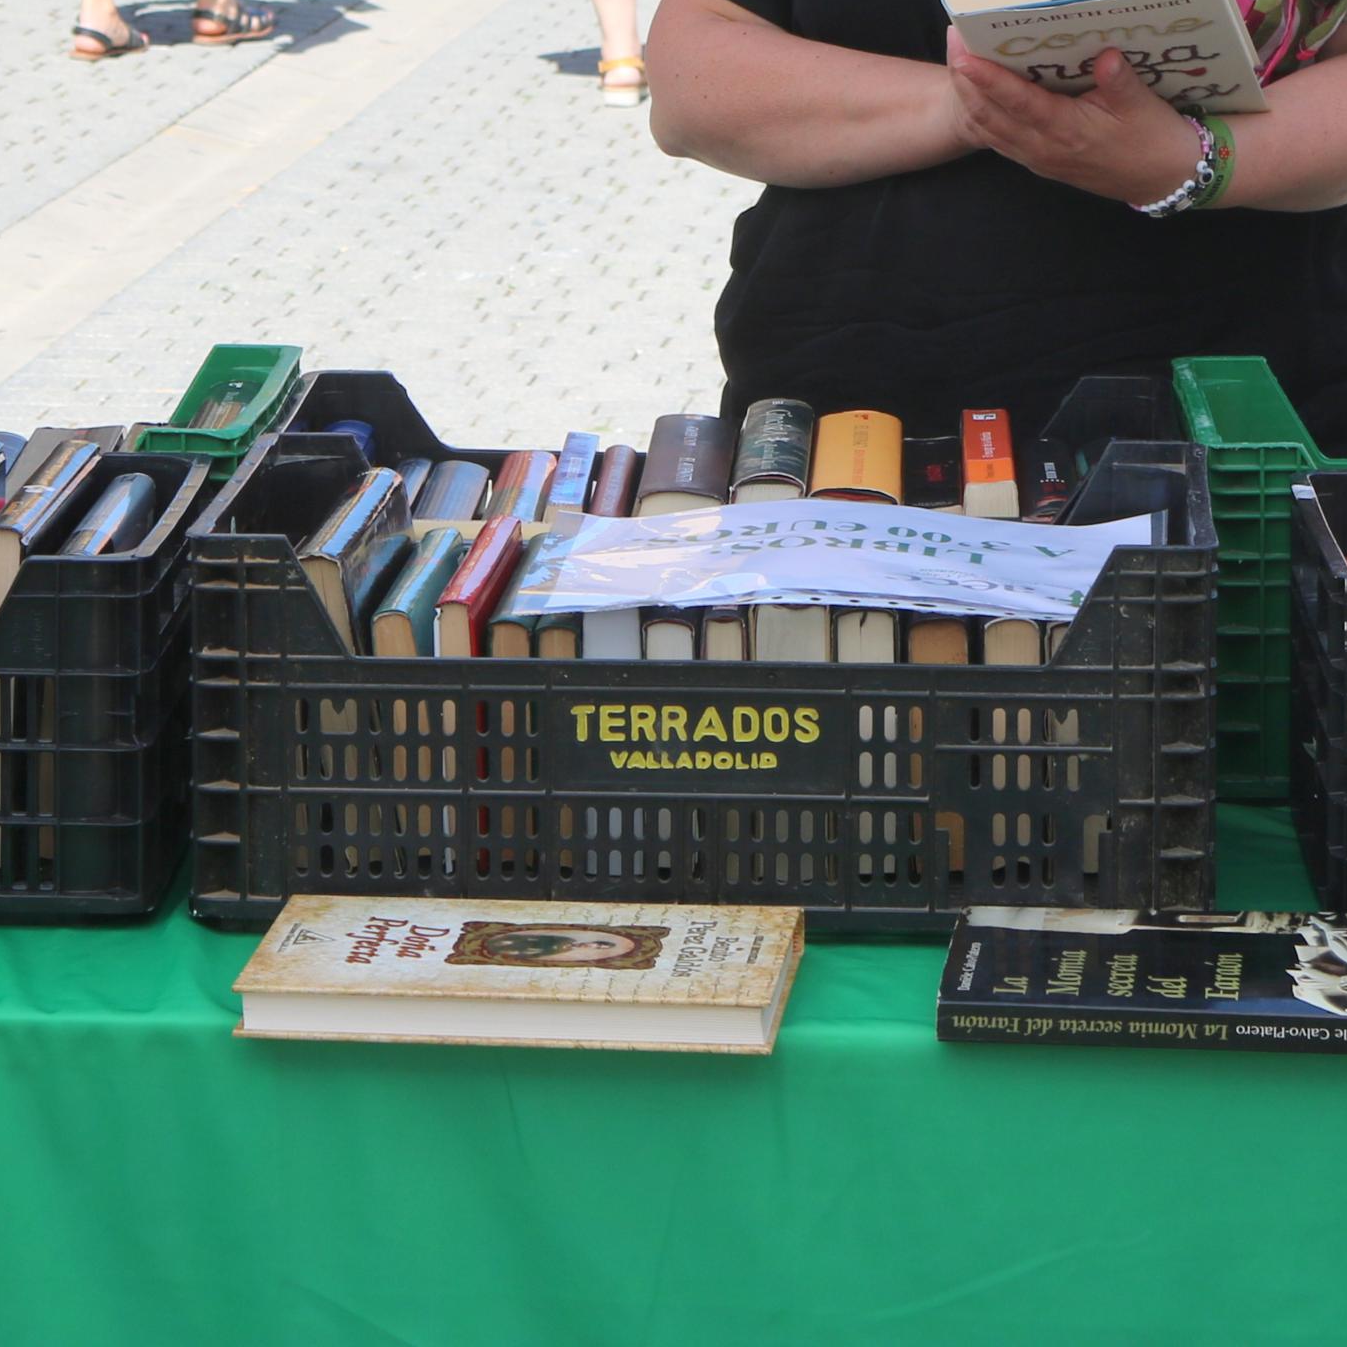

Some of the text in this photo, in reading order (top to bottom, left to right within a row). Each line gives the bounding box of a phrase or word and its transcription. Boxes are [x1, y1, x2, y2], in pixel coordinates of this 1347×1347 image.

[990, 10, 1104, 30] ELIZABETH
[993, 16, 1215, 57] come
[710, 536, 987, 566] LIBROS:
[1032, 545, 1075, 558] A
[570, 705, 820, 744] TERRADOS
[610, 751, 778, 769] VALLADOLID
[345, 916, 409, 964] Perfecta
[396, 924, 450, 959] Doña
[671, 920, 718, 977] Pérez Galdós
[708, 936, 739, 963] Benito
[992, 975, 1029, 996] La
[1045, 949, 1087, 997] Momia
[1106, 953, 1139, 998] secreta
[1147, 975, 1188, 999] del
[1204, 952, 1243, 1001] Faraón
[951, 1014, 1230, 1040] La Momia secreta del Faraón
[1235, 1024, 1331, 1041] Calvo-Platero
